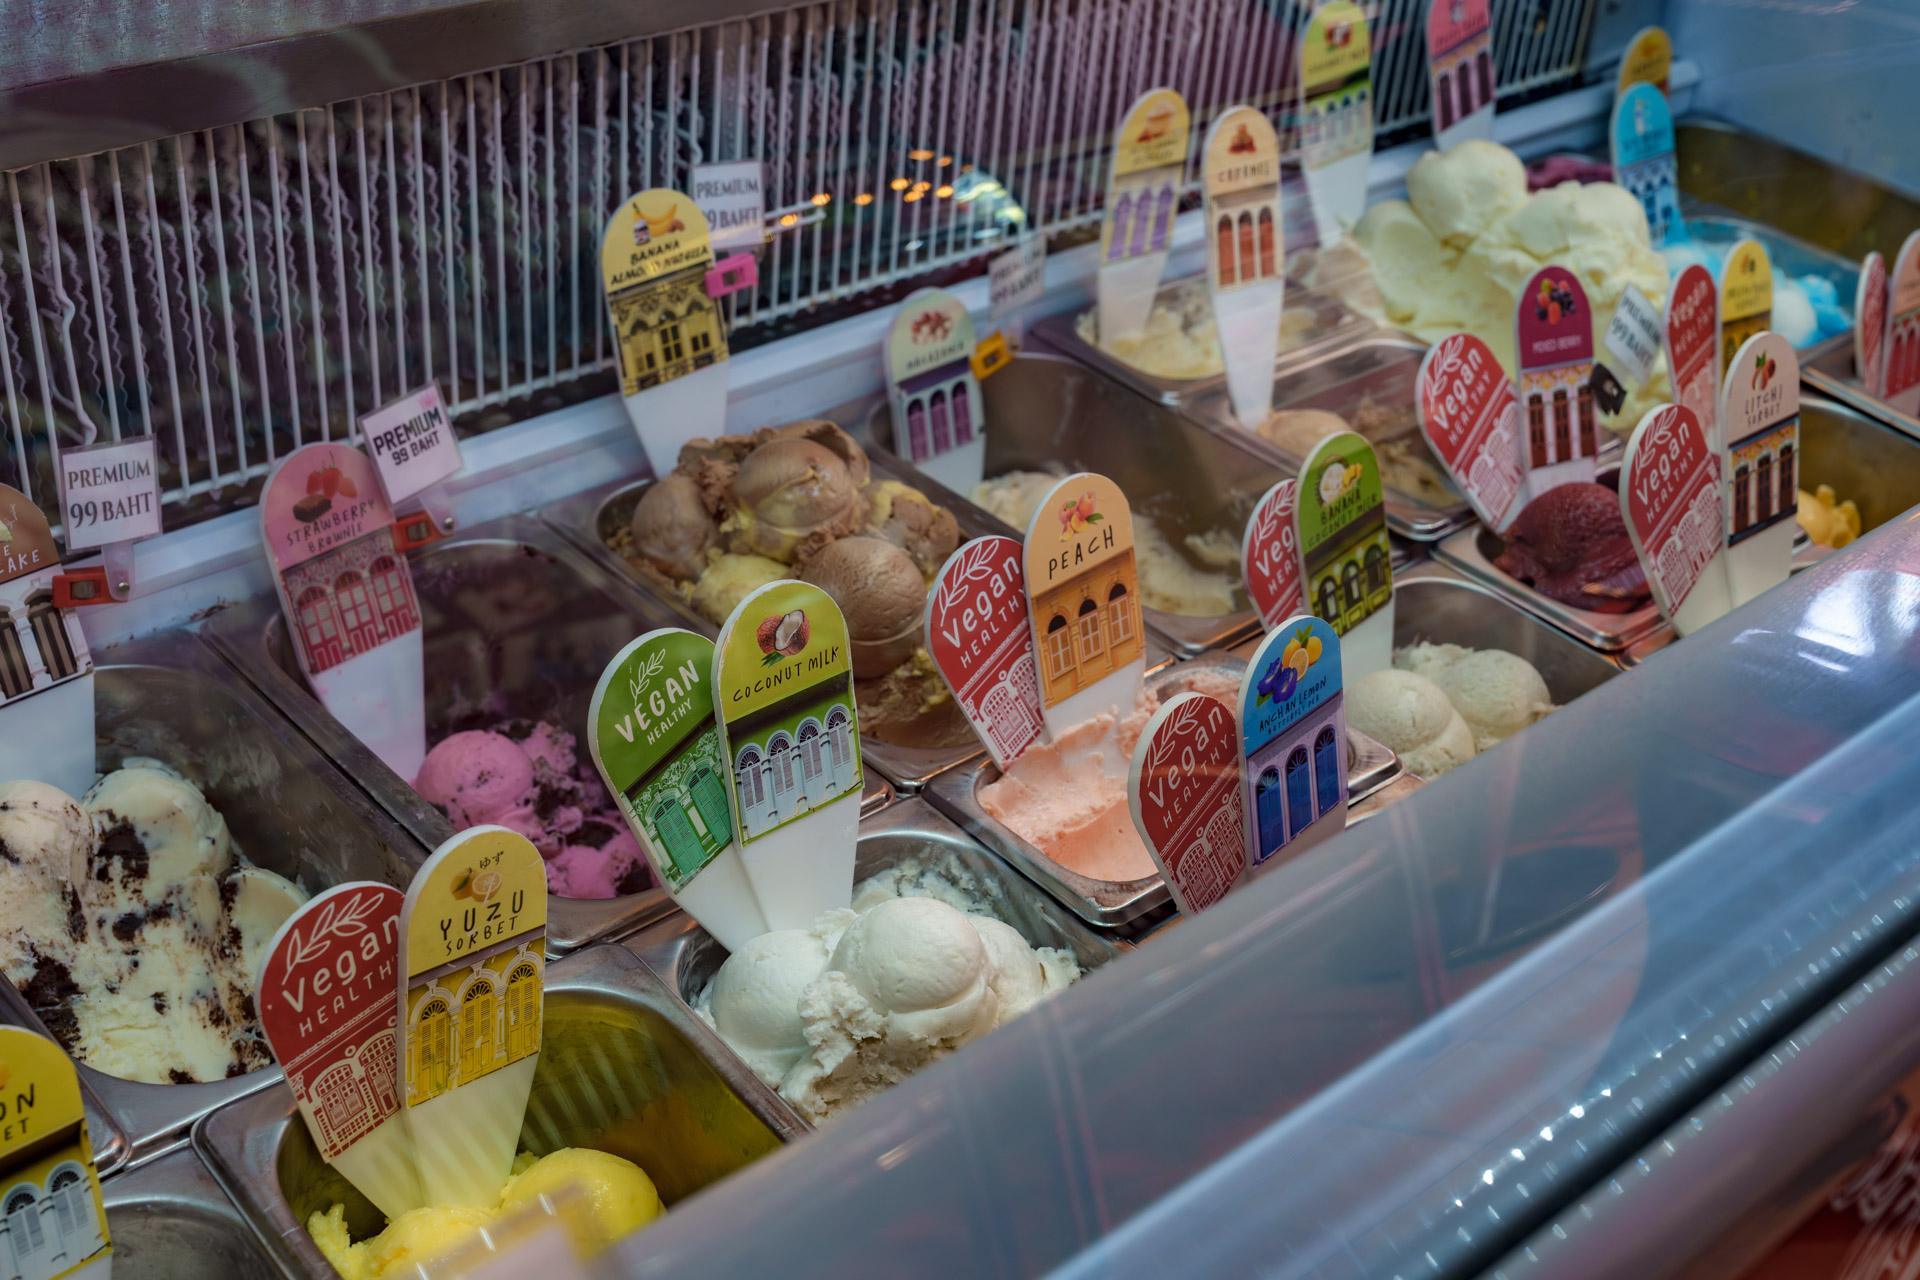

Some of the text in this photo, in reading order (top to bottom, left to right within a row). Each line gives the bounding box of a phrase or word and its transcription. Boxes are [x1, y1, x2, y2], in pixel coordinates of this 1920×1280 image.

[696, 180, 759, 199] PREMIUM
[720, 207, 759, 228] BAHT
[630, 239, 680, 266] BANANA
[372, 407, 443, 456] PREMIUM
[1448, 371, 1491, 446] HEALTHY
[392, 431, 441, 466] 99 BAHT
[68, 459, 151, 490] PREMIUM
[1647, 447, 1695, 523] HEALTHY
[70, 491, 153, 529] 99 BAHT
[286, 498, 376, 547] STRAWBERRY
[0, 549, 40, 574] AKE
[307, 522, 364, 553] BROWNIE
[1048, 524, 1115, 580] PEACH
[960, 589, 1025, 669] HEALTH
[732, 645, 840, 702] COCONUT MILK
[613, 659, 700, 744] VEGAN
[646, 697, 694, 746] HEALTHY
[1259, 674, 1328, 733] ANCHAN LEMON
[1162, 733, 1231, 829] HEALTHY
[479, 850, 504, 870] ゆず
[440, 888, 524, 942] YUZU
[445, 914, 519, 957] SORBET
[298, 952, 398, 1038] HEALTH
